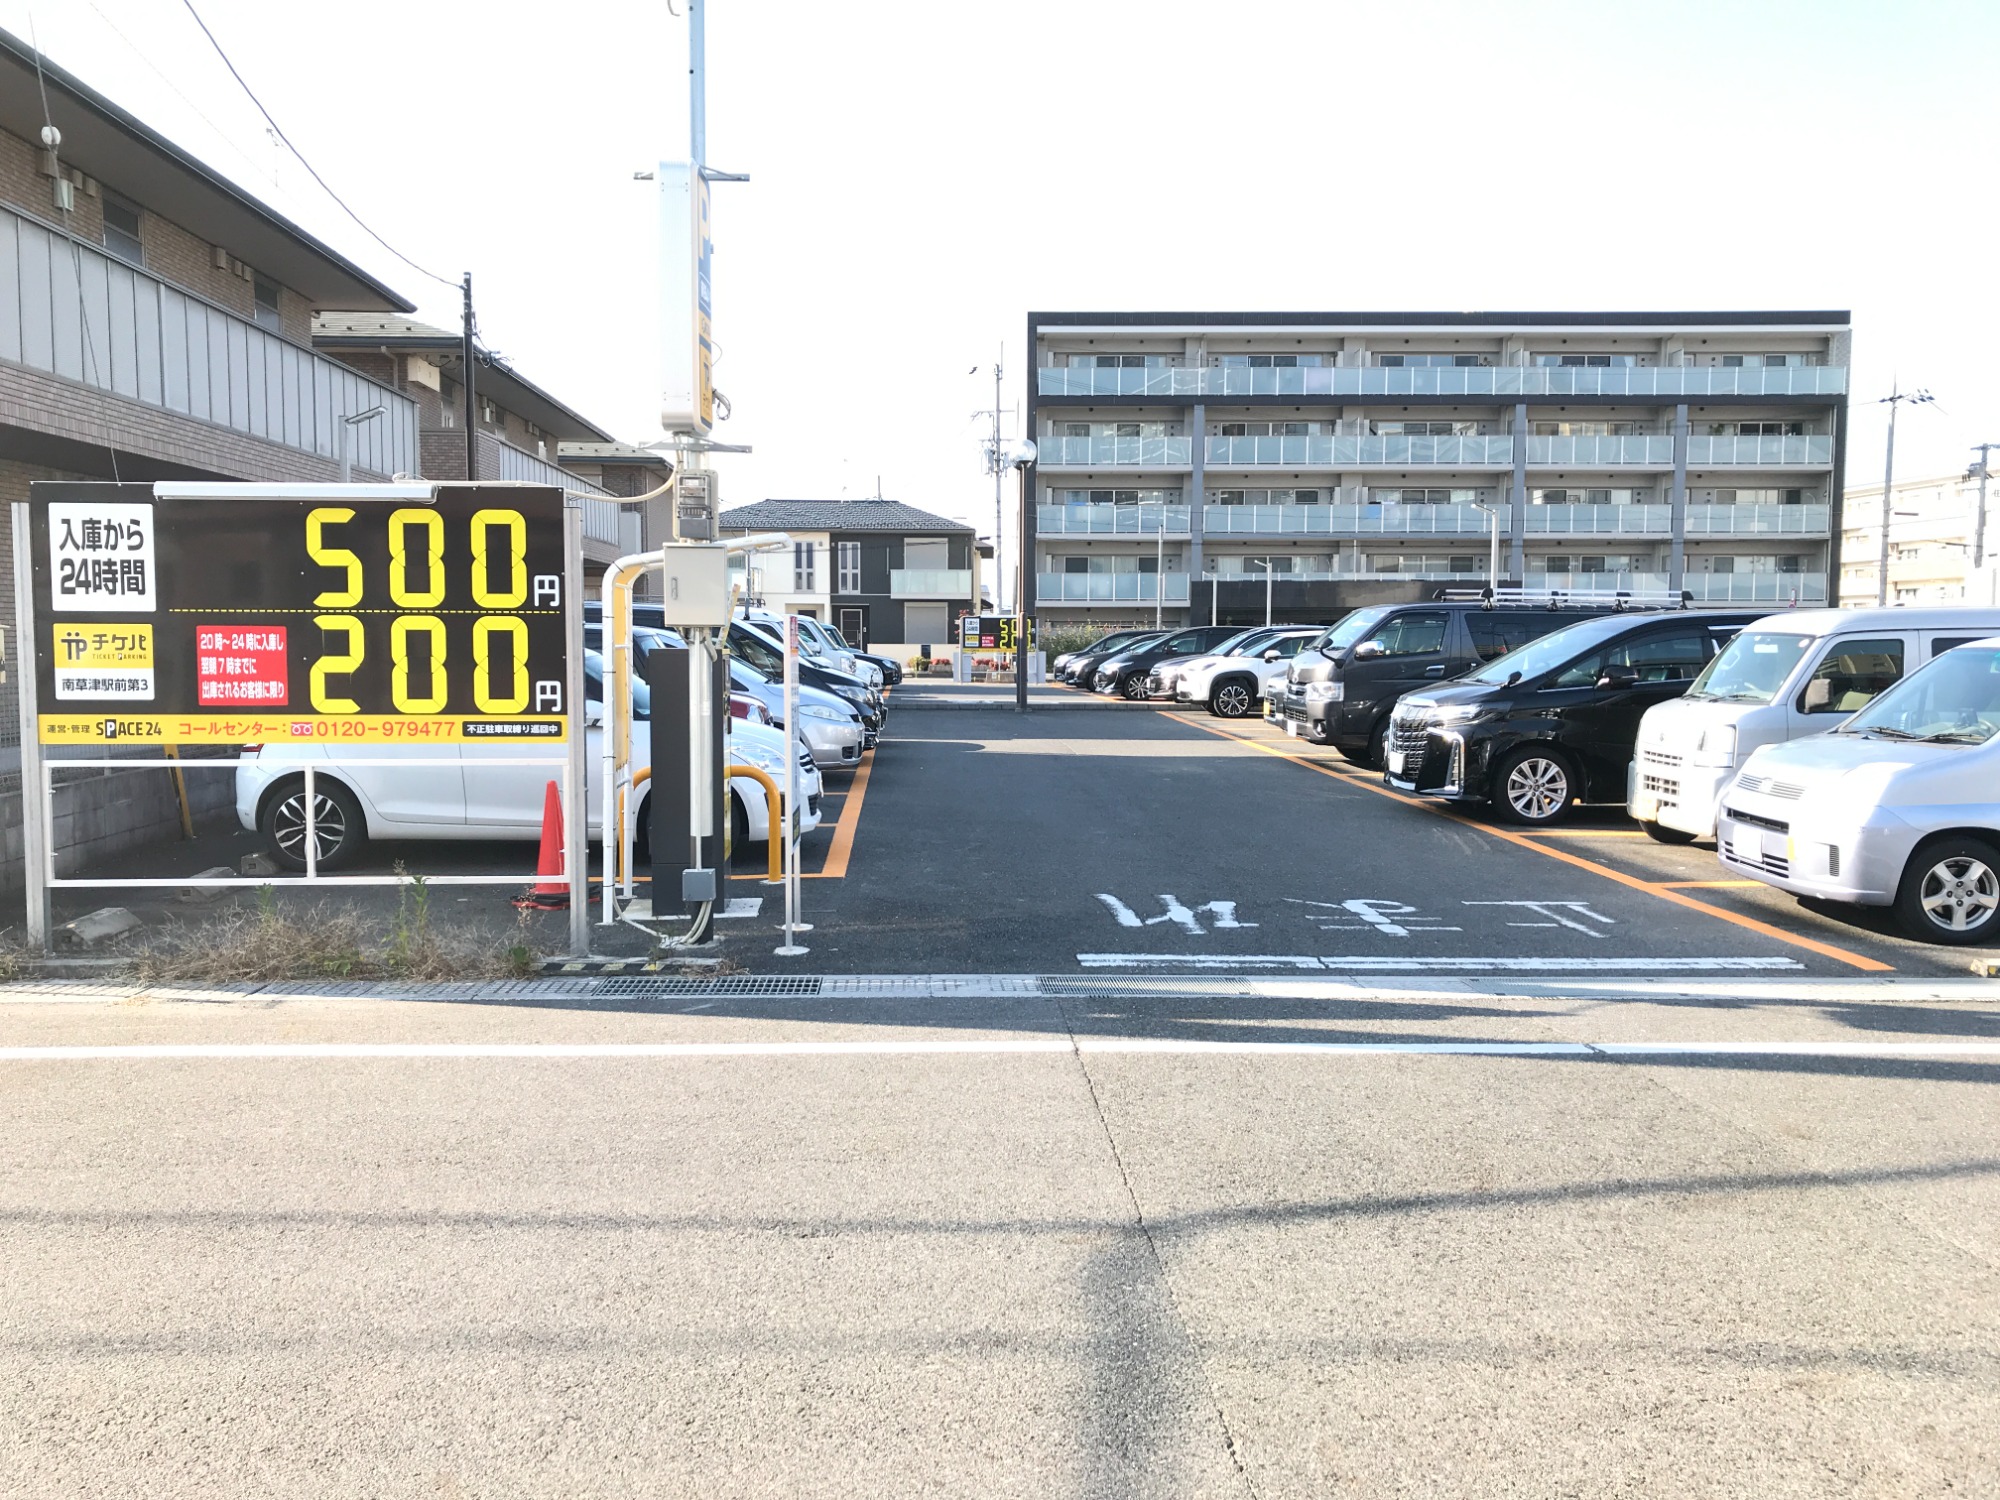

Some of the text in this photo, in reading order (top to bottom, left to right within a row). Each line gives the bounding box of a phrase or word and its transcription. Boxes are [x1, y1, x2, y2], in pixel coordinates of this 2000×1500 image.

[59, 517, 145, 552] 入庫から
[305, 507, 561, 609] 500 円
[60, 557, 146, 596] 24時間
[91, 633, 147, 651] チケパ
[92, 652, 148, 661] TICKET PARKING
[309, 614, 562, 714] 200 円
[61, 677, 149, 692] 南草津駅前第3
[316, 721, 456, 738] 0120-979477
[466, 724, 559, 735] 不正駐車取締り巡回中
